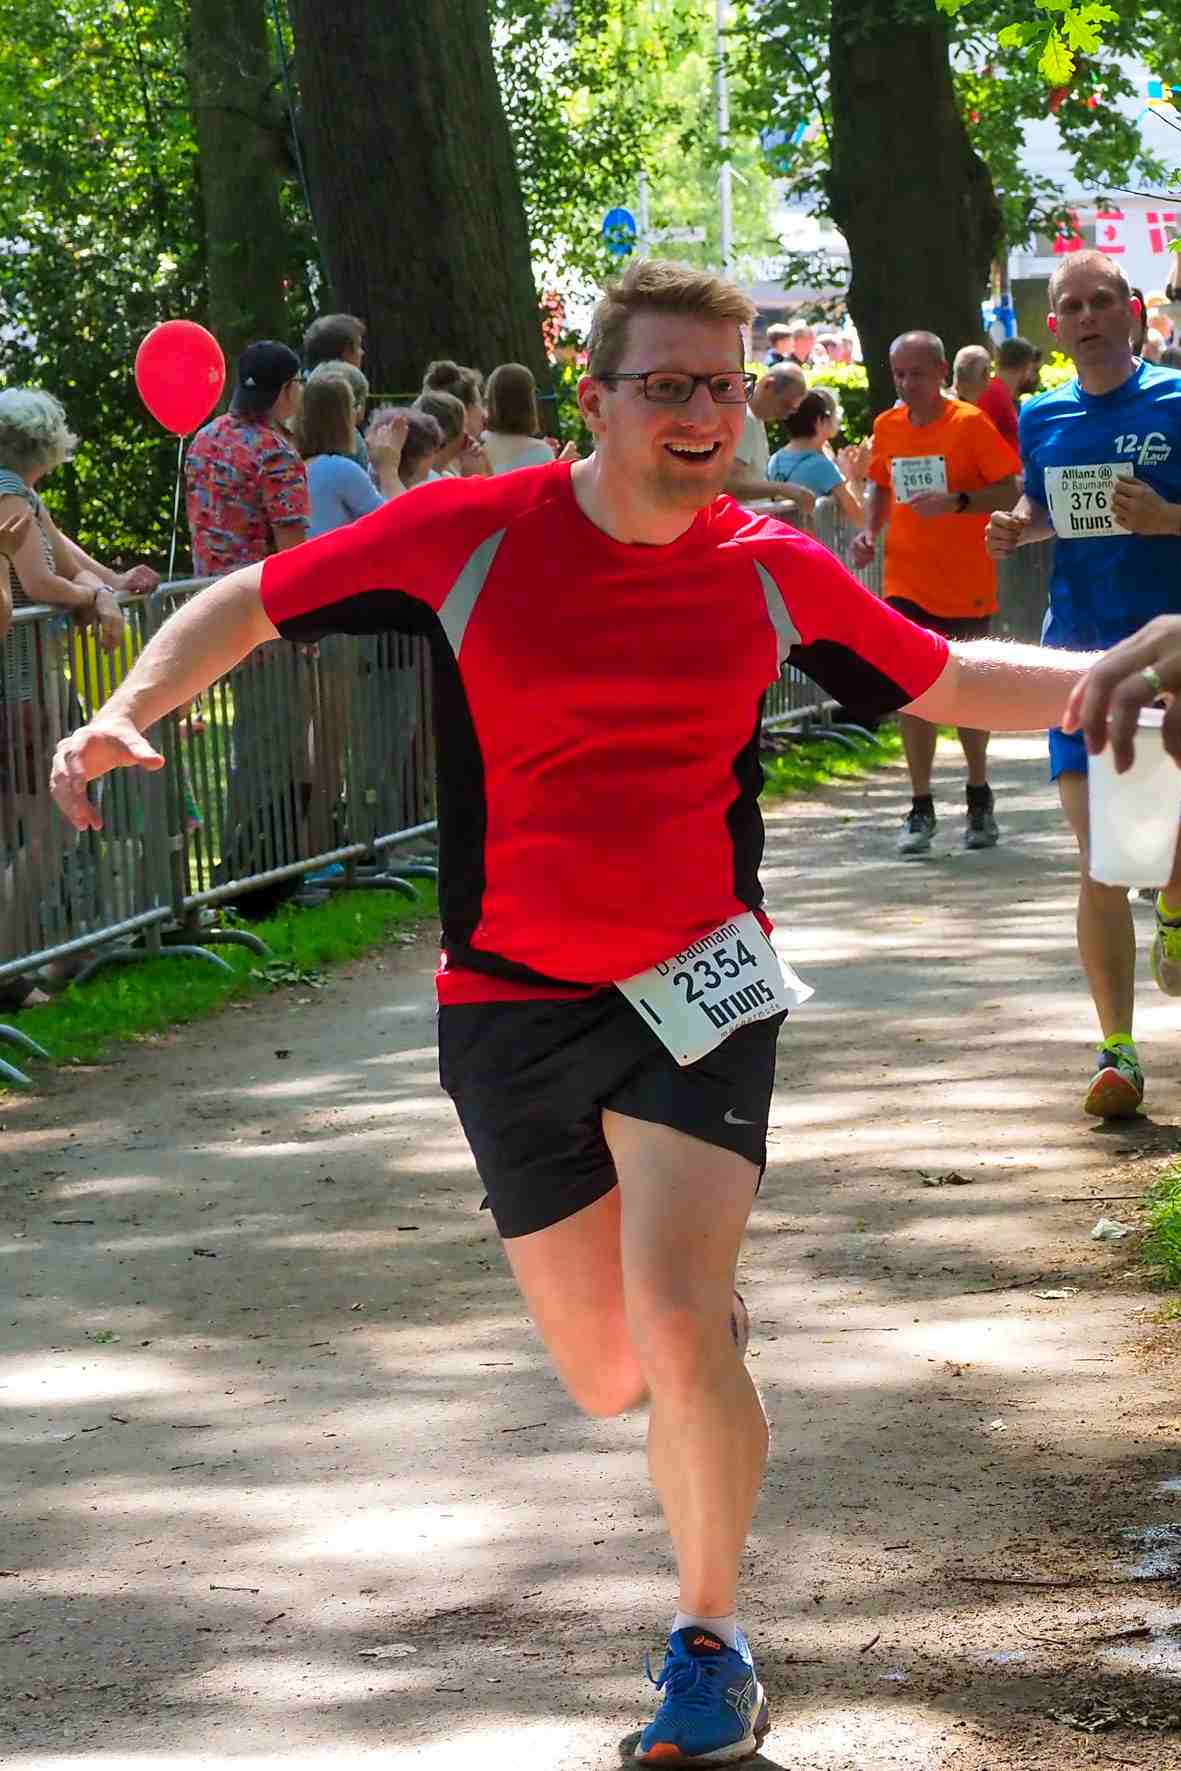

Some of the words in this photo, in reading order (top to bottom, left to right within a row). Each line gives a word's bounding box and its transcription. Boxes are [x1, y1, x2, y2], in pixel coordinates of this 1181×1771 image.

[1062, 469, 1096, 480] Allianz
[1071, 491, 1107, 510] 376
[1070, 513, 1112, 530] bruns
[673, 939, 757, 1004] 2354
[699, 979, 775, 1029] bruns
